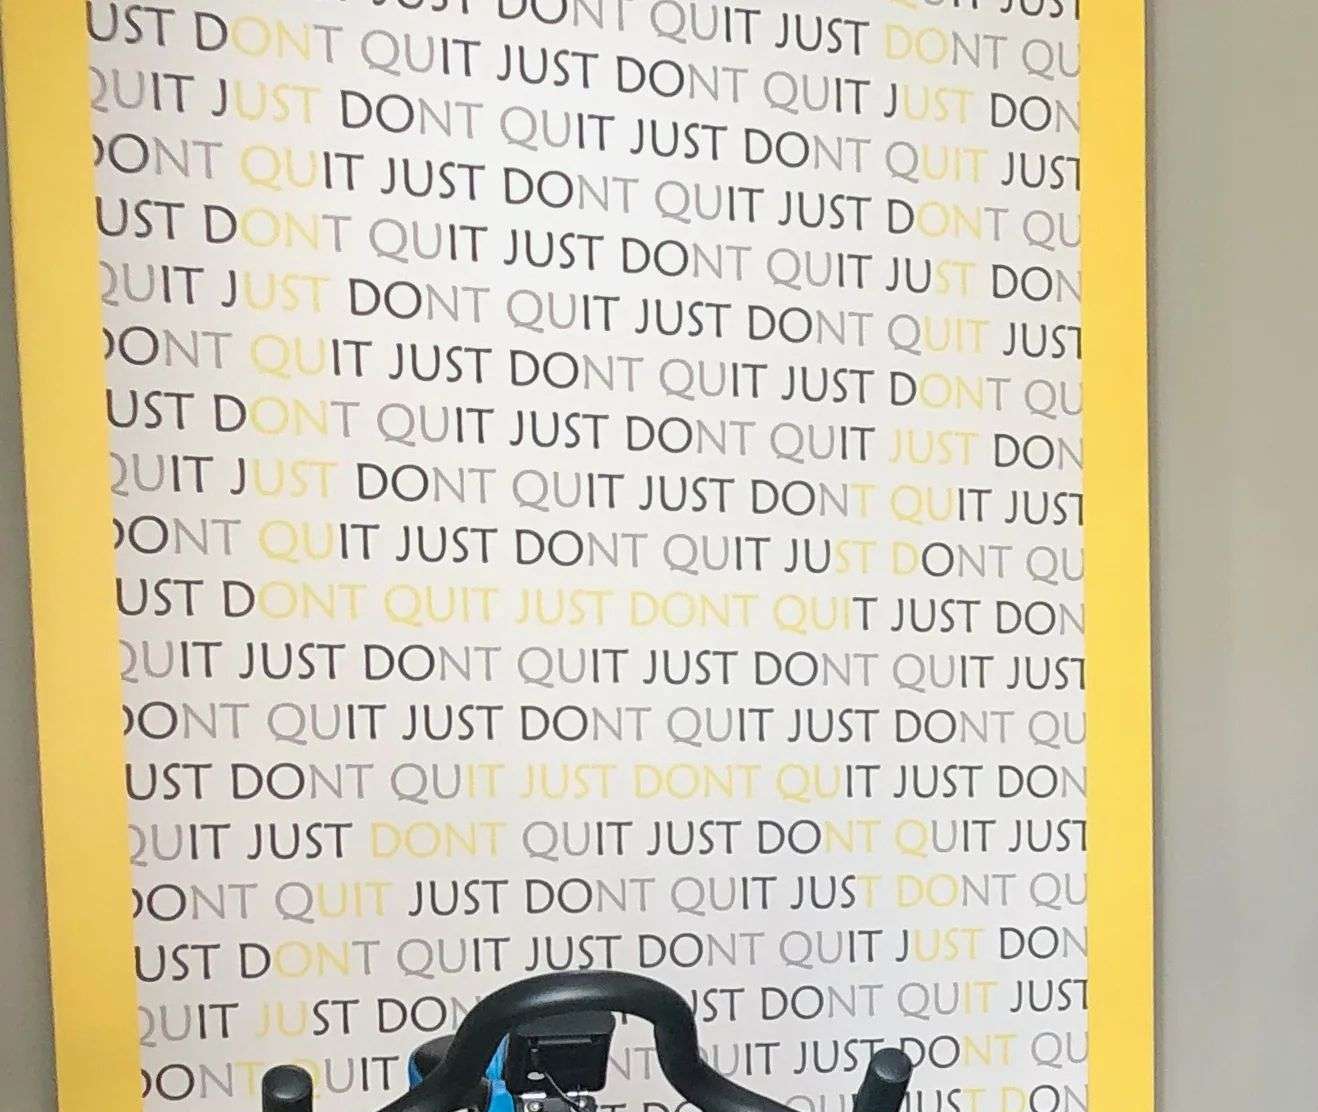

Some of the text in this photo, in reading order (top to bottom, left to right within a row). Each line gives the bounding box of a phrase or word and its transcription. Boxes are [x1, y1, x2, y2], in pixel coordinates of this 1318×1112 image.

[193, 10, 975, 124] DONT QUIT JUST DONT QUIT JUST
[239, 143, 1009, 241] QUIT JUST DONT QUIT JUST DONT
[221, 270, 991, 356] JUST DONT QUIT JUST DONT QUIT
[213, 392, 979, 465] DONT QUIT JUST DONT QUIT JUST
[256, 519, 1013, 578] QUIT JUST DONT QUIT JUST DONT
[238, 642, 994, 693] JUST DONT QUIT JUST DONT QUIT
[267, 702, 775, 748] QUIT JUST DONT QUIT
[231, 761, 983, 805] DONT QUIT DONT QUIT JUST
[275, 873, 1016, 924] QUIT JUST DONT QUIT JUST DONT
[239, 929, 883, 979] DONT QUIT
[256, 981, 999, 1039] JUST DONT QUIT
